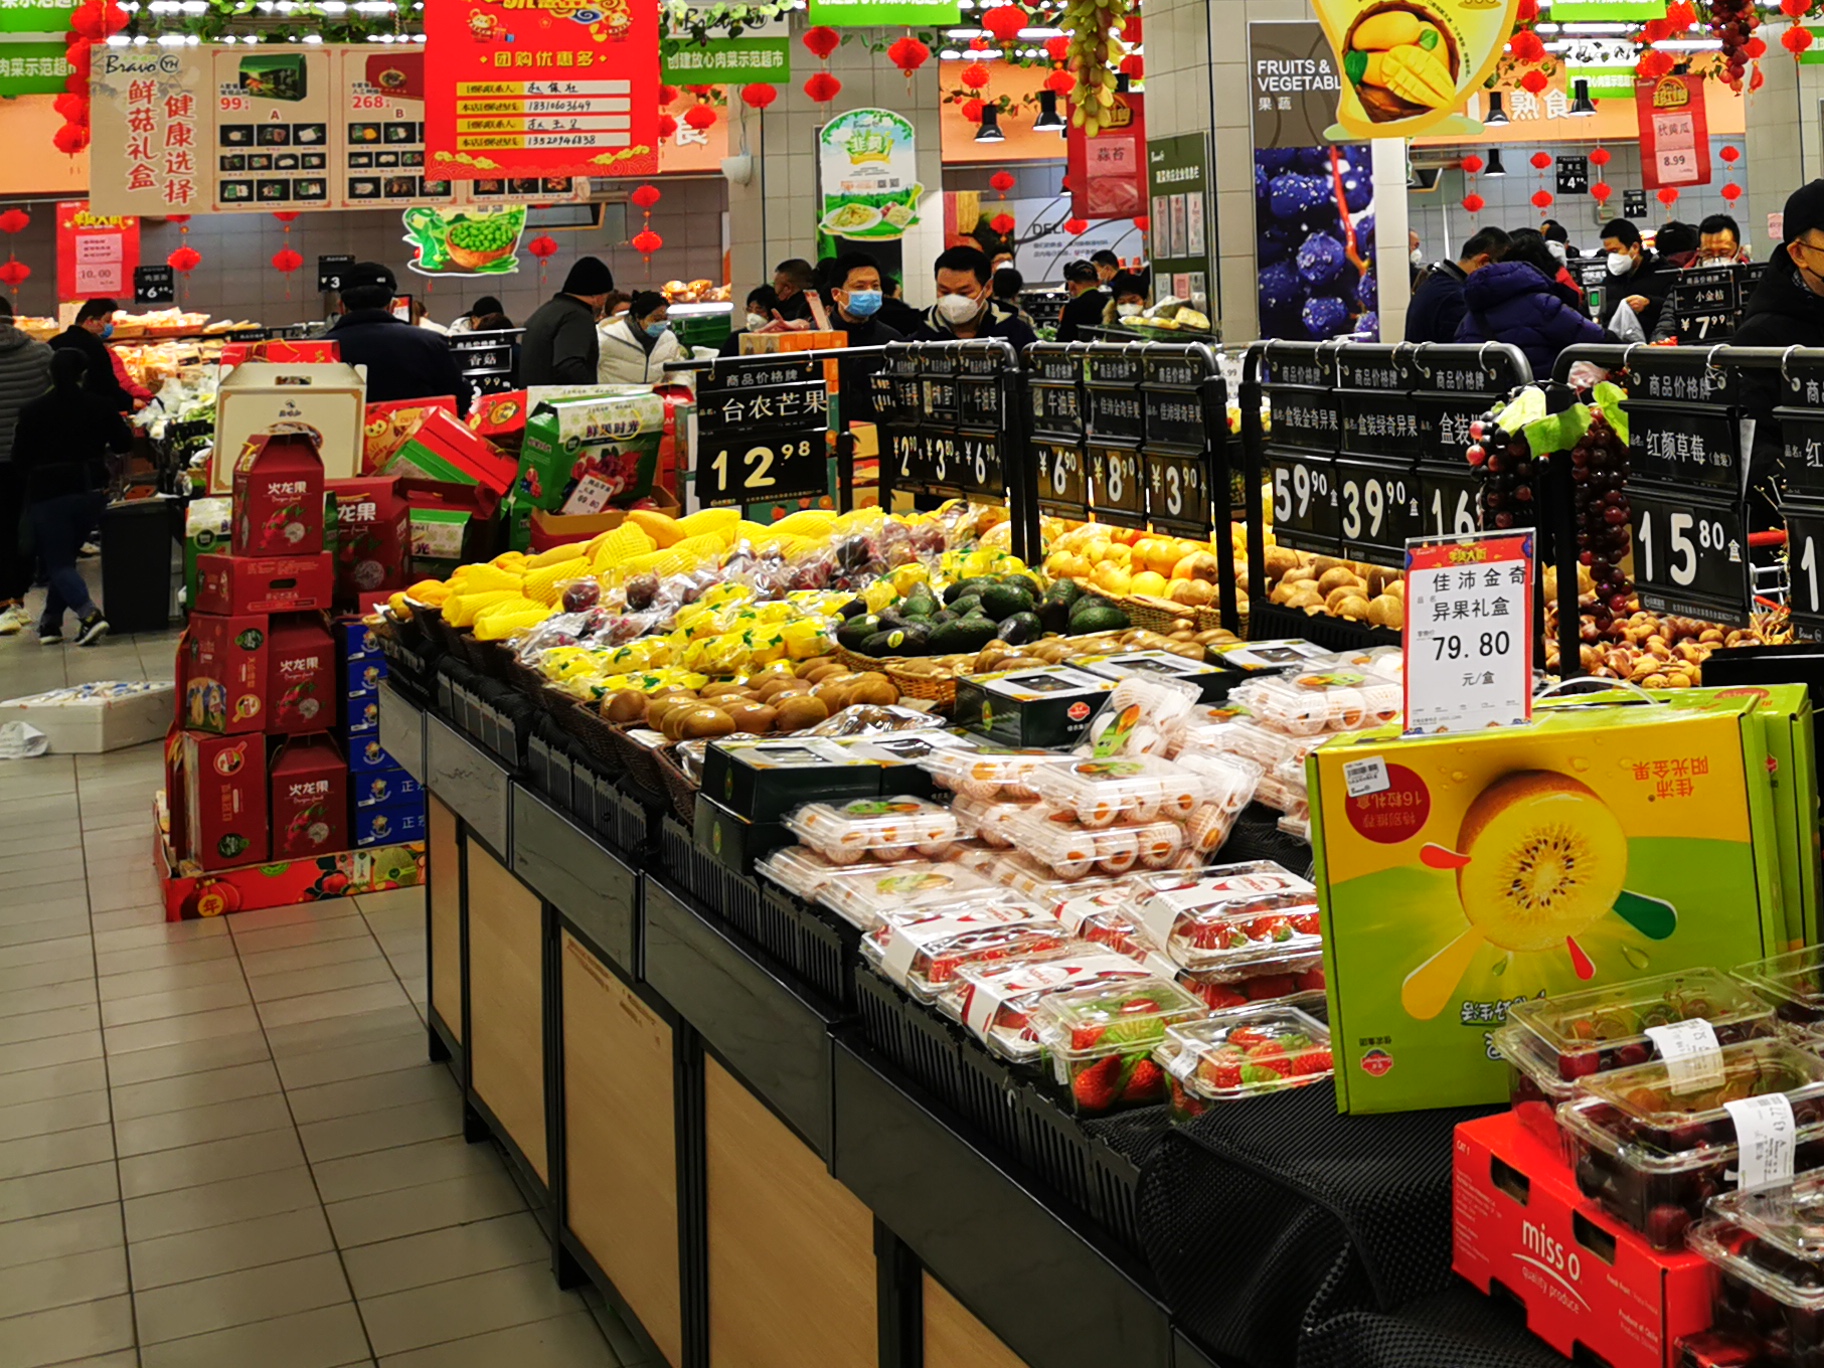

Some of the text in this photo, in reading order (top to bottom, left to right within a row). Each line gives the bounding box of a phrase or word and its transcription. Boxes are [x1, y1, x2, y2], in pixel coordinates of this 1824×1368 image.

[105, 55, 157, 74] Bravo
[494, 50, 594, 67] 团购优惠多
[667, 50, 784, 70] 创建放心肉菜示范超市
[1256, 59, 1331, 76] FRUITS &
[1257, 75, 1342, 92] VEGETABL
[220, 97, 242, 111] 99
[352, 95, 384, 109] 268
[1258, 96, 1292, 111] 果蔬
[1510, 89, 1571, 122] 熟食
[270, 111, 280, 121] A
[395, 109, 404, 119] B
[126, 79, 158, 192] 鲜菇礼盒
[164, 93, 197, 206] 健康选择
[1664, 155, 1686, 166] 8.99
[1695, 289, 1725, 303] 小金桔
[468, 352, 497, 367] 香菇
[727, 369, 798, 387] 商品价格牌
[722, 390, 828, 423] 台农芒果
[974, 386, 997, 412] 牛油果
[1048, 390, 1077, 417] 牛油果
[1285, 406, 1339, 432] 盒装金奇异果
[1357, 413, 1418, 438] 盒装绿奇异果
[1646, 429, 1706, 466] 红颜草莓
[711, 440, 811, 491] 12.98
[267, 480, 307, 495] 火龙果
[337, 502, 377, 521] 龙果
[1432, 566, 1527, 593] 佳沛金奇
[1432, 596, 1511, 623] 异果礼盒
[1432, 630, 1511, 661] 79.80
[279, 657, 319, 673] 火龙果
[1462, 670, 1496, 688] 元/盒
[1632, 754, 1709, 782] 阳光金果
[288, 780, 329, 797] 火龙果
[1655, 779, 1695, 800] 佳沛
[1523, 1219, 1565, 1270] miss
[1521, 1266, 1548, 1294] quality
[1549, 1284, 1580, 1315] produce
